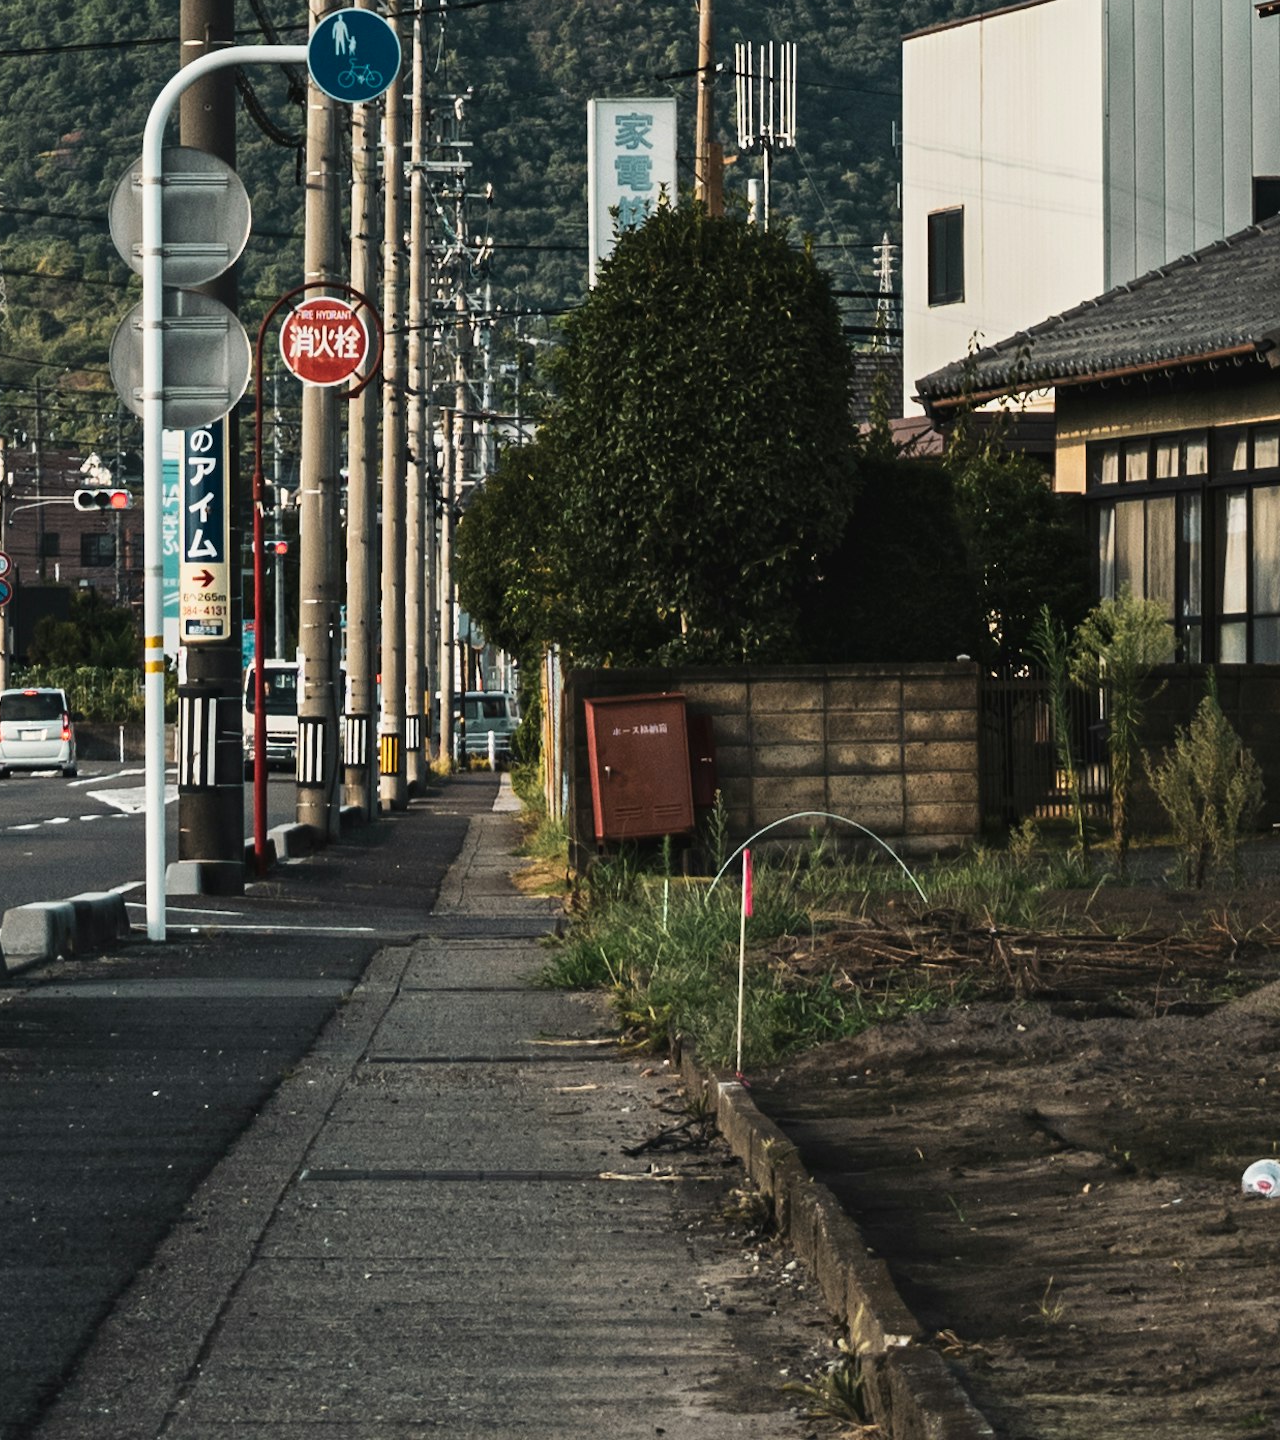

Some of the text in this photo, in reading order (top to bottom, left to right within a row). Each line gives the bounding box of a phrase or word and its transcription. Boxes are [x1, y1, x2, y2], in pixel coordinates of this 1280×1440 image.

[296, 310, 352, 319] FIRE HYDRANT
[289, 325, 361, 358] 消火栓
[188, 425, 218, 558] のアイム
